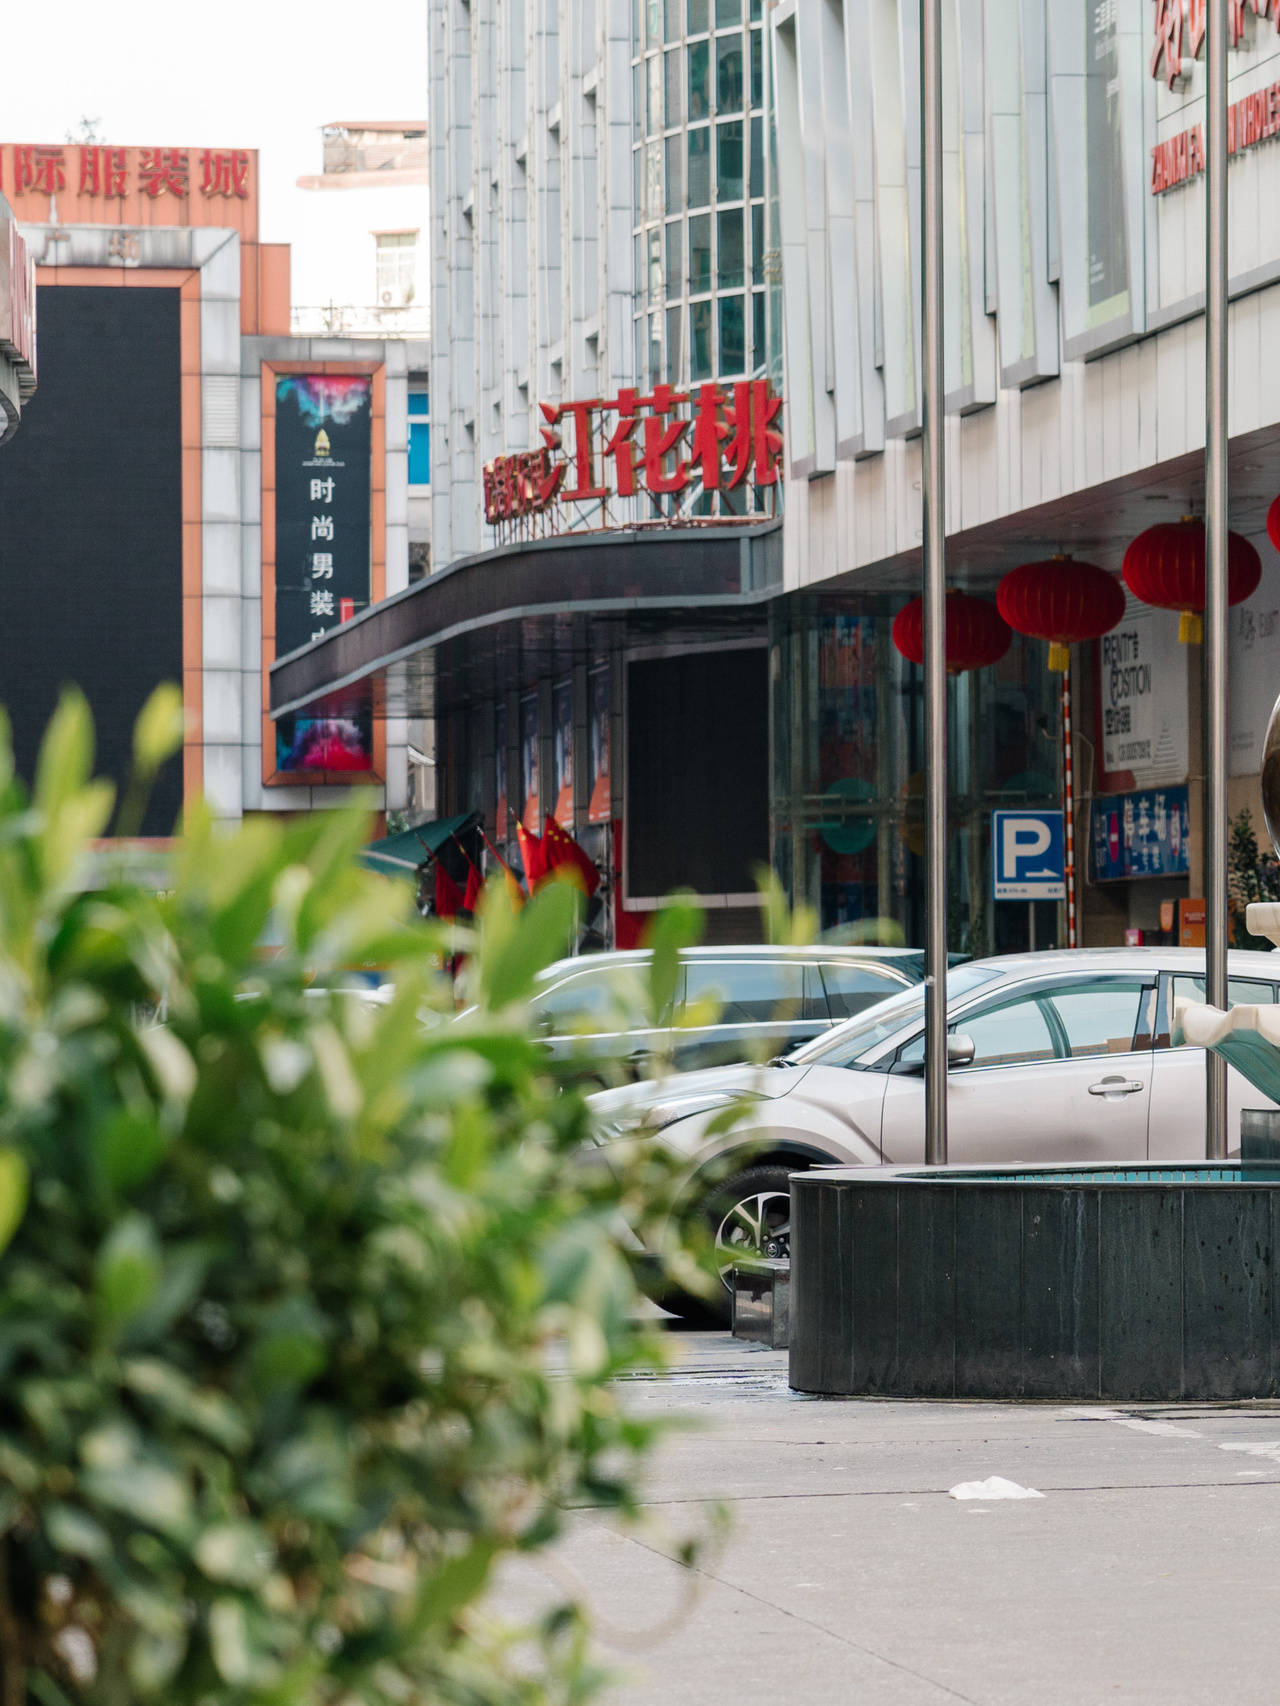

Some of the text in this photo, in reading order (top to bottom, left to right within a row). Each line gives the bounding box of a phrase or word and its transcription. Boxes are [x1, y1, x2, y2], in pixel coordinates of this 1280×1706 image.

[0, 146, 249, 198] 际服装城
[309, 476, 336, 642] 时尚男装
[1003, 818, 1052, 879] P
